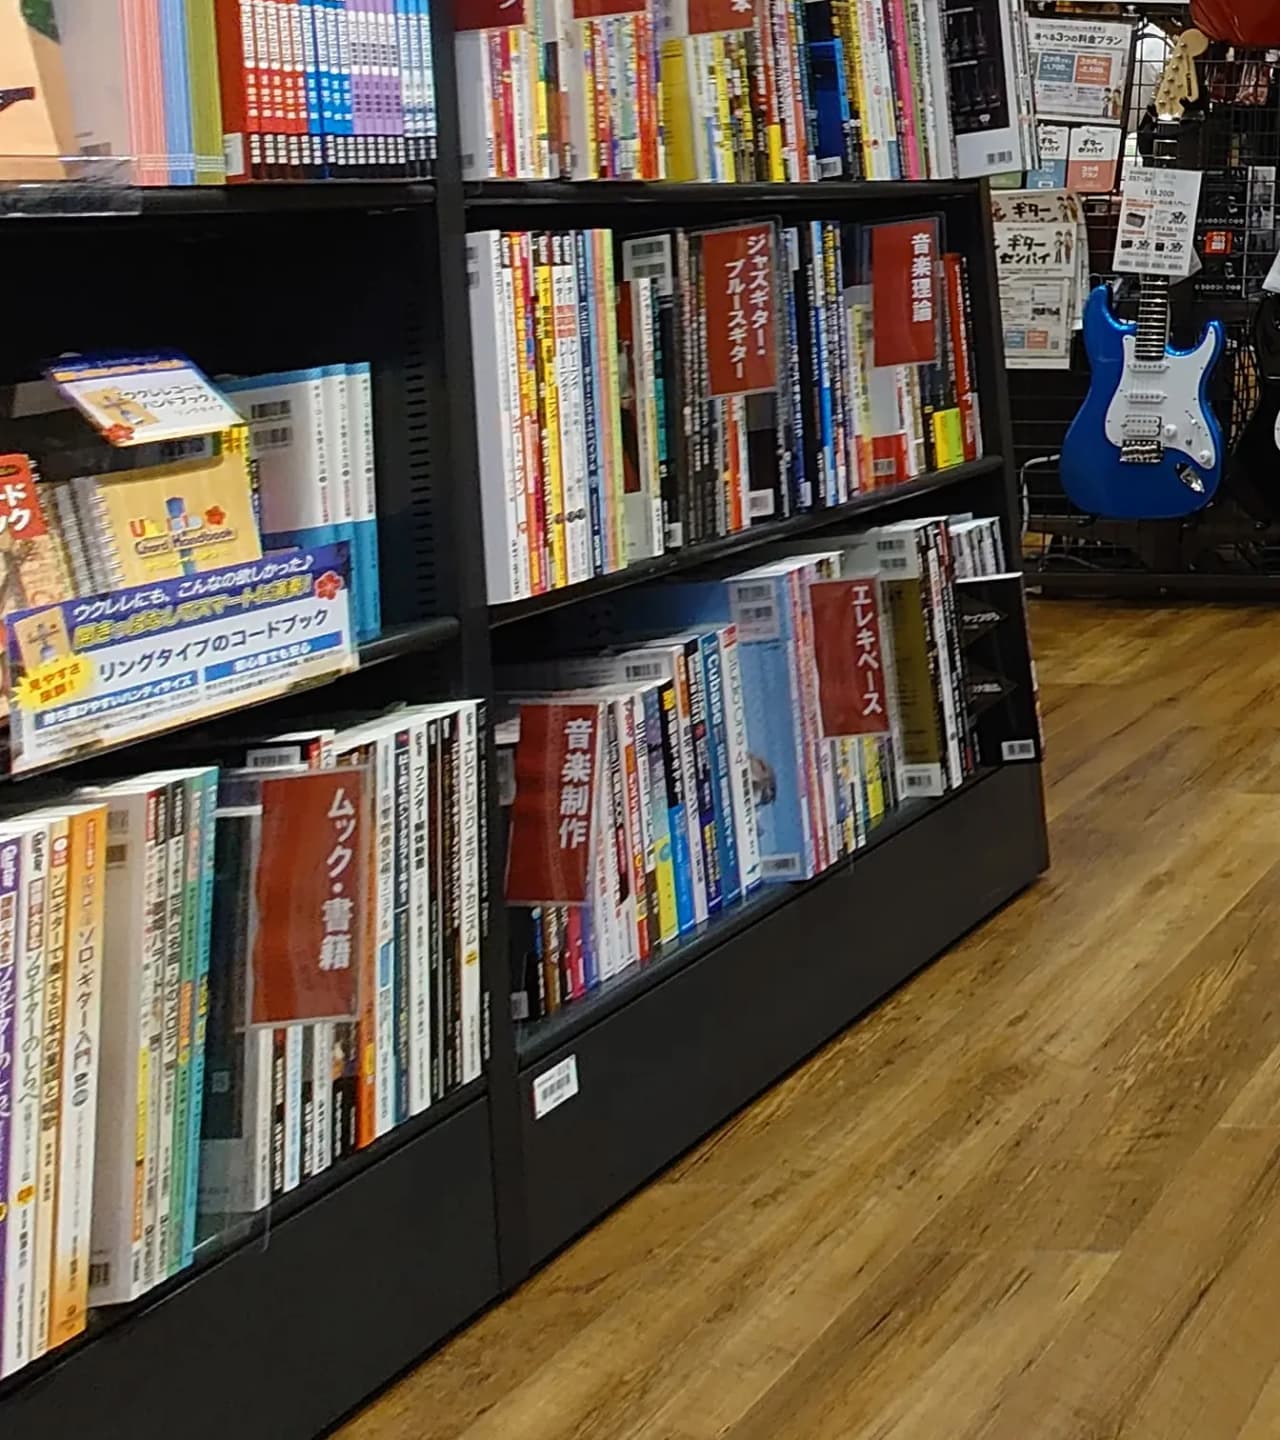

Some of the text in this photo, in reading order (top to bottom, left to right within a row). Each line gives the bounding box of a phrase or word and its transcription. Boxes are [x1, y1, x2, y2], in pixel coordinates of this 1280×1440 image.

[1008, 233, 1047, 252] ギター
[1012, 201, 1052, 219] ギター
[911, 233, 932, 323] 音楽理論
[999, 252, 1050, 265] センパイ
[723, 258, 746, 381] ブルースギター
[99, 608, 328, 684] リングタイプのコードブック
[851, 585, 884, 717] エレキベース
[706, 653, 723, 725] Cubase
[558, 717, 595, 851] 音楽制作
[318, 787, 356, 972] ムック・書籍
